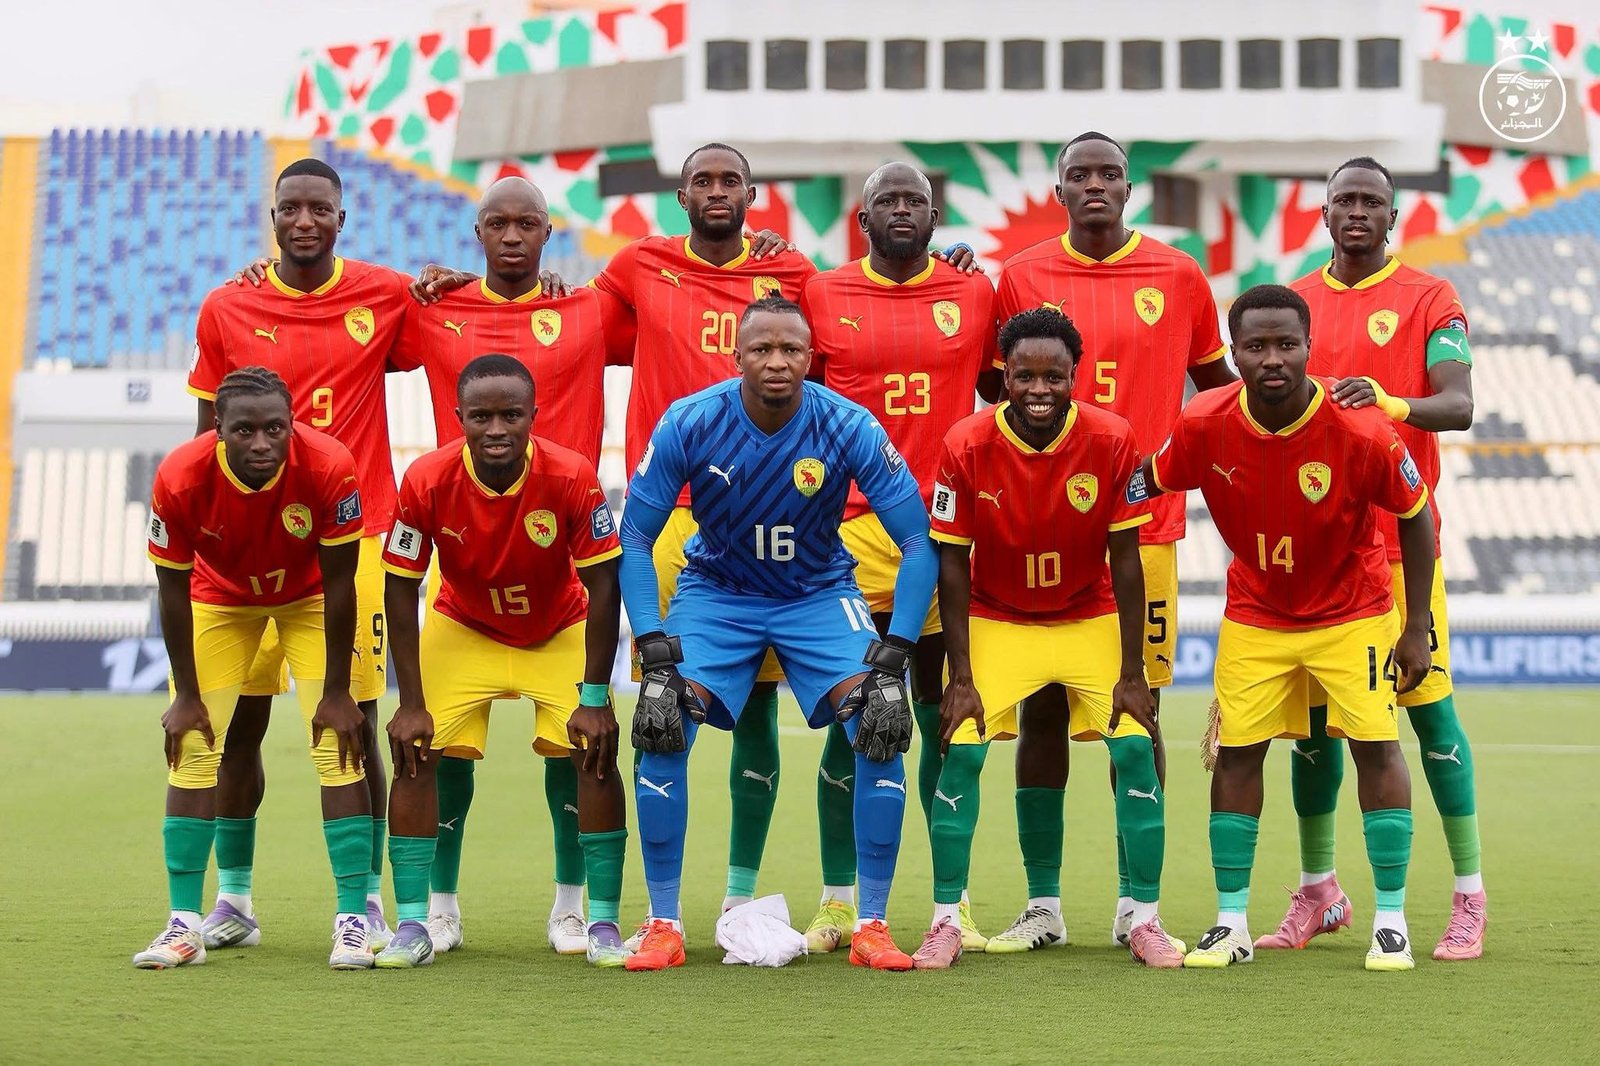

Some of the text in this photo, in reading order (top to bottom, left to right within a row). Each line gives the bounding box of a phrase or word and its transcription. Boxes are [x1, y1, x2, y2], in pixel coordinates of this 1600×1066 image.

[701, 310, 737, 355] 20
[884, 372, 930, 416] 23
[1095, 361, 1117, 404] 5
[311, 387, 334, 427] 9
[755, 524, 795, 562] 16
[1256, 533, 1294, 573] 14
[249, 569, 285, 595] 17
[1026, 551, 1061, 588] 10
[489, 584, 530, 615] 15
[839, 597, 879, 635] 16
[373, 613, 384, 656] 9
[1148, 600, 1166, 644] 5
[1368, 646, 1398, 692] 14
